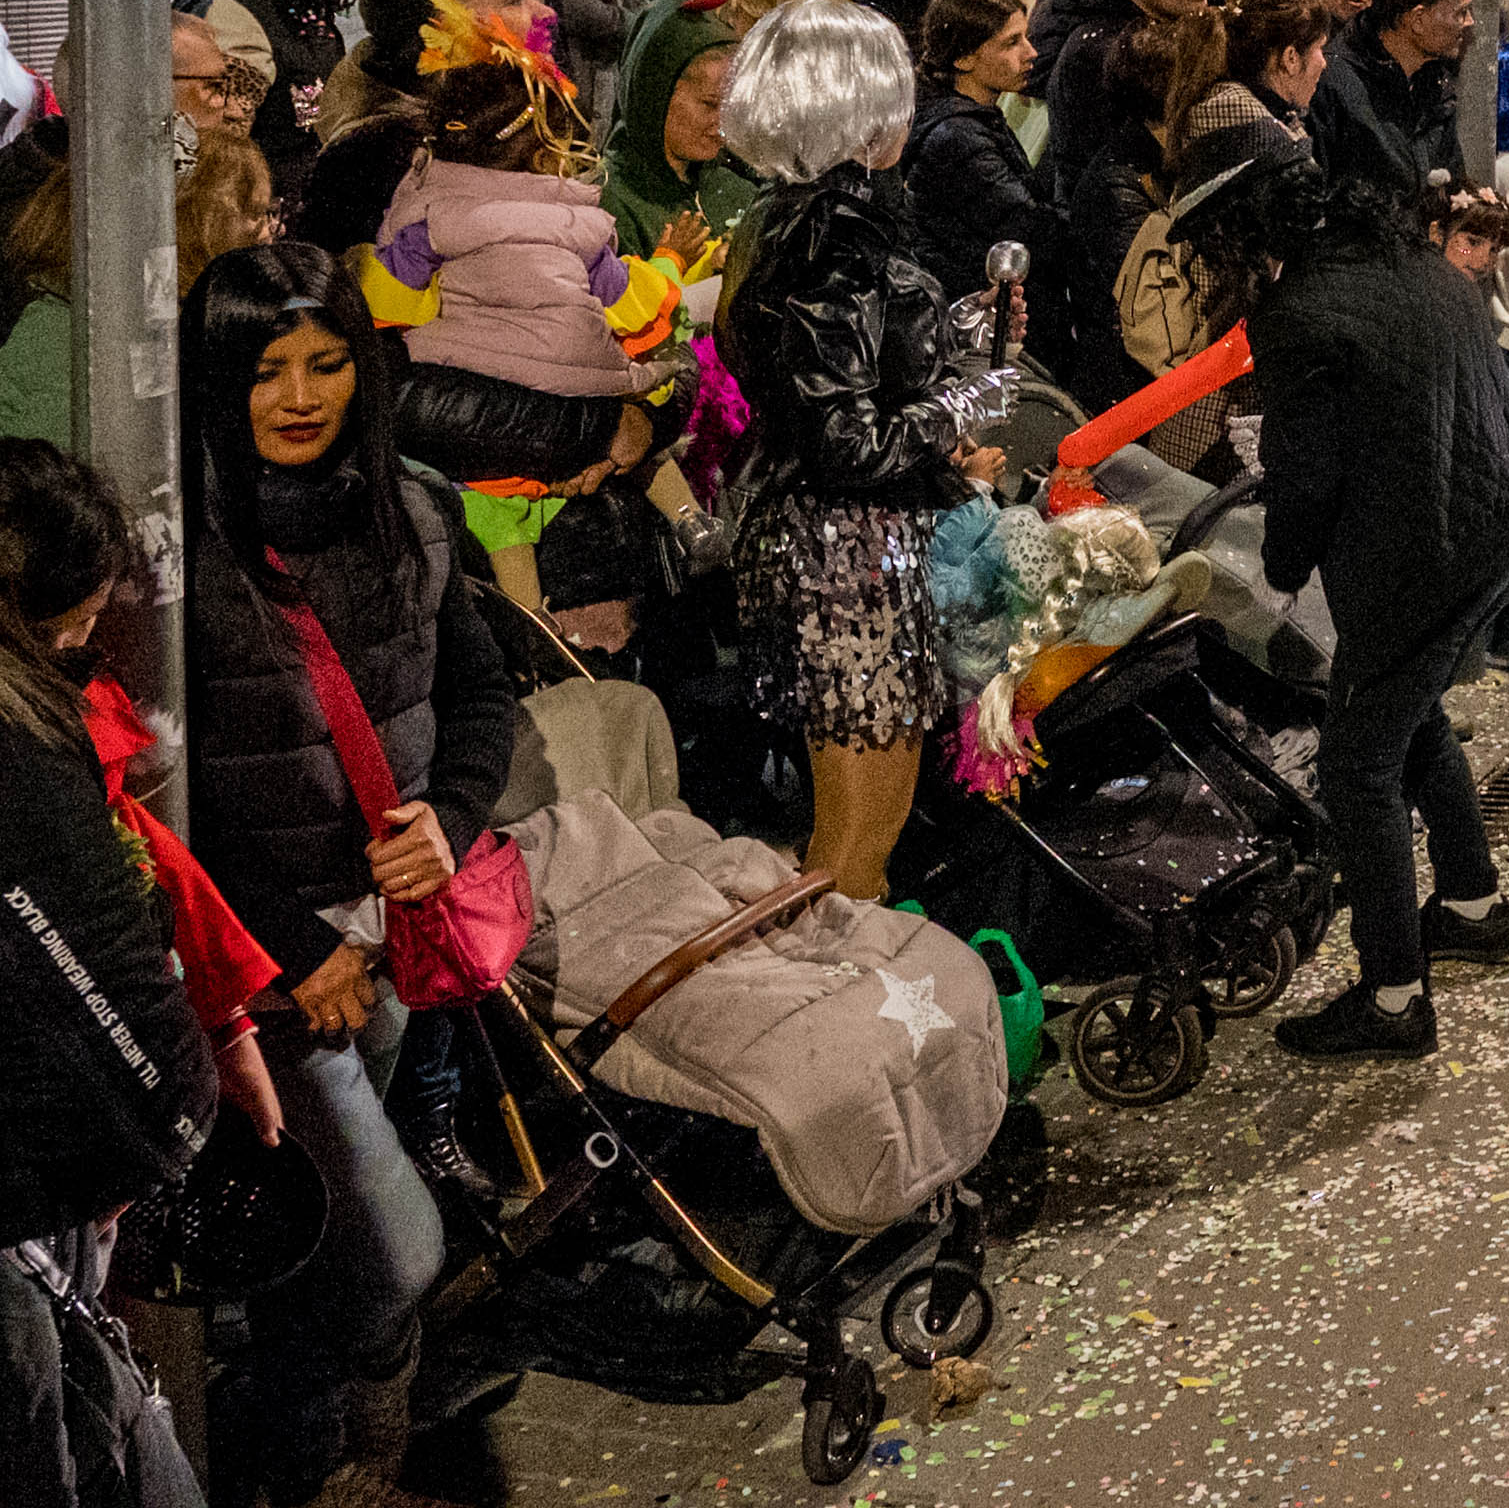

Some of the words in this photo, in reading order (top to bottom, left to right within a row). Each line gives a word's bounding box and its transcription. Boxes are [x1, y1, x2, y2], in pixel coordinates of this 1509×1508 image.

[3, 885, 50, 934] BLACK
[39, 929, 96, 996] WEARING
[84, 992, 120, 1028] STOP
[109, 1022, 147, 1069] NEVER
[137, 1058, 162, 1091] I'LL
